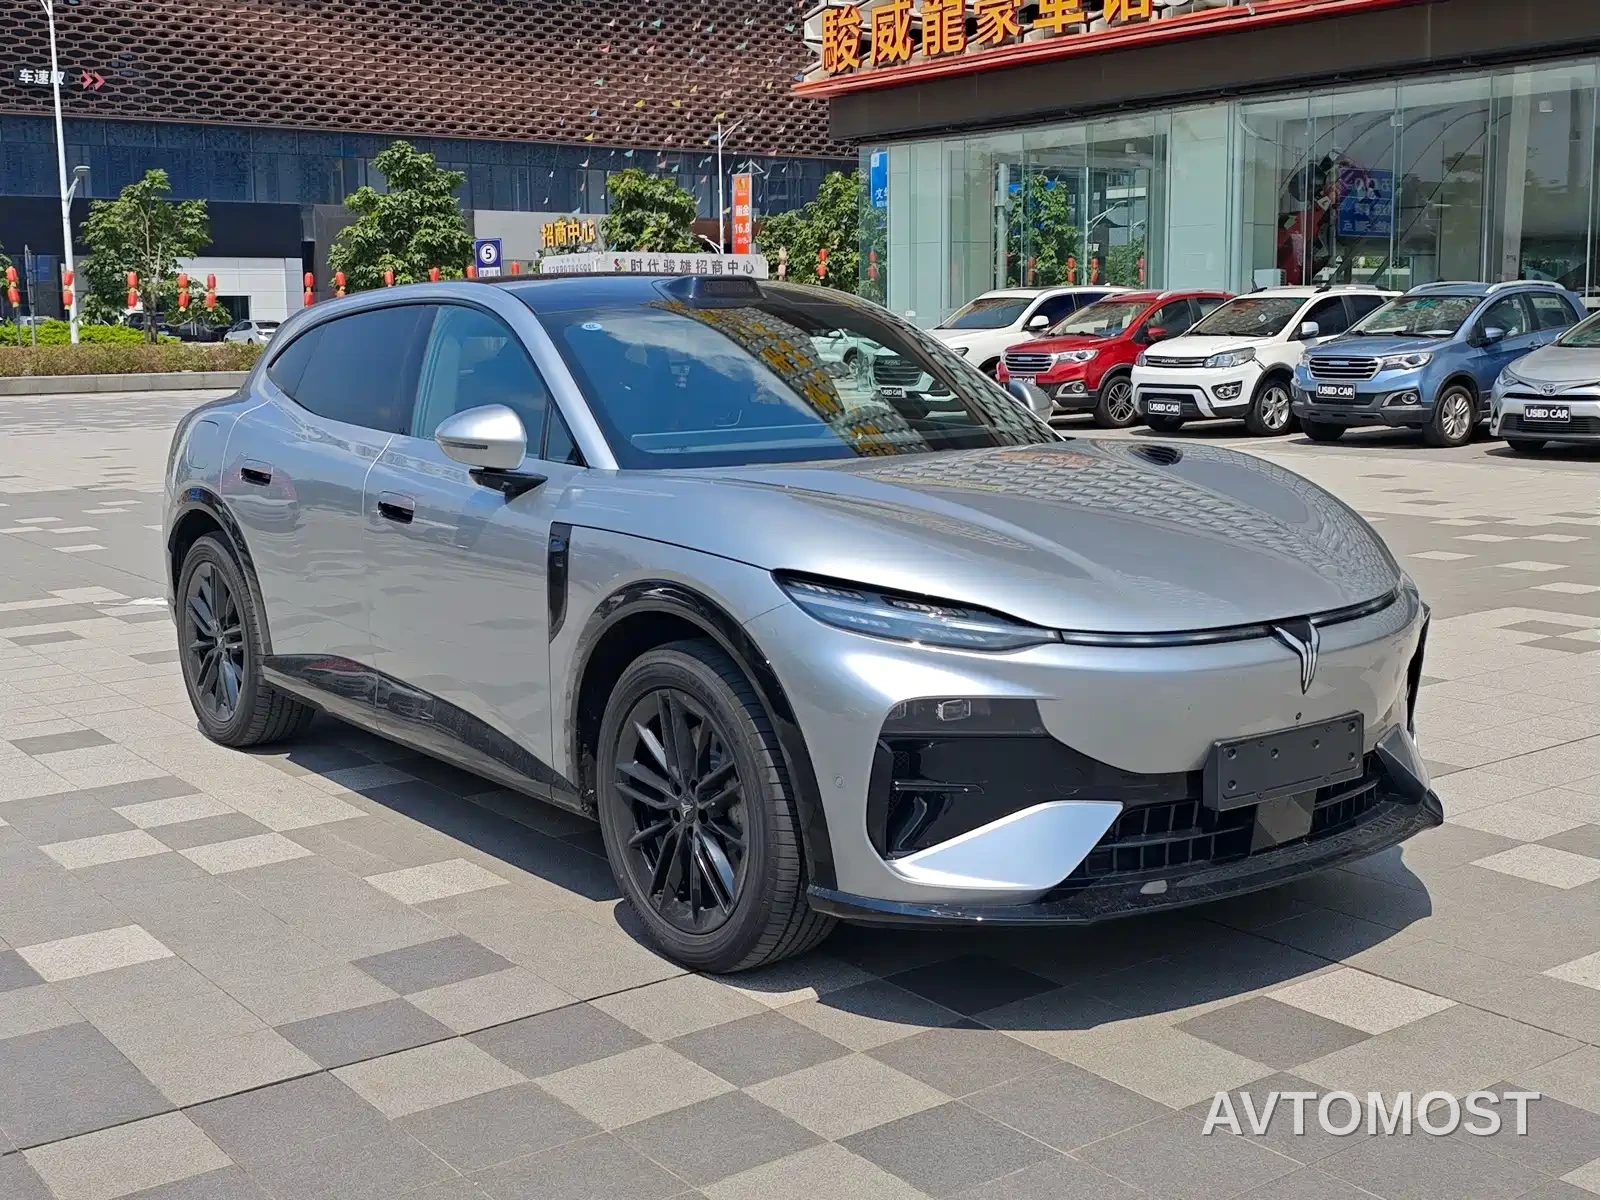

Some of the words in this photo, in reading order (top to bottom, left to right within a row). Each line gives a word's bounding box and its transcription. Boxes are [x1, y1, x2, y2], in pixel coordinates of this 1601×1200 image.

[542, 218, 596, 248] 招商中心
[734, 223, 750, 234] 16.8
[485, 248, 492, 260] 5
[630, 258, 755, 275] 时代骏雄招商中心
[1318, 386, 1337, 395] USED
[1338, 387, 1353, 396] CAR
[1150, 403, 1165, 411] USED
[1166, 404, 1179, 412] CAR
[1525, 408, 1548, 418] USED
[1549, 409, 1568, 419] CAR
